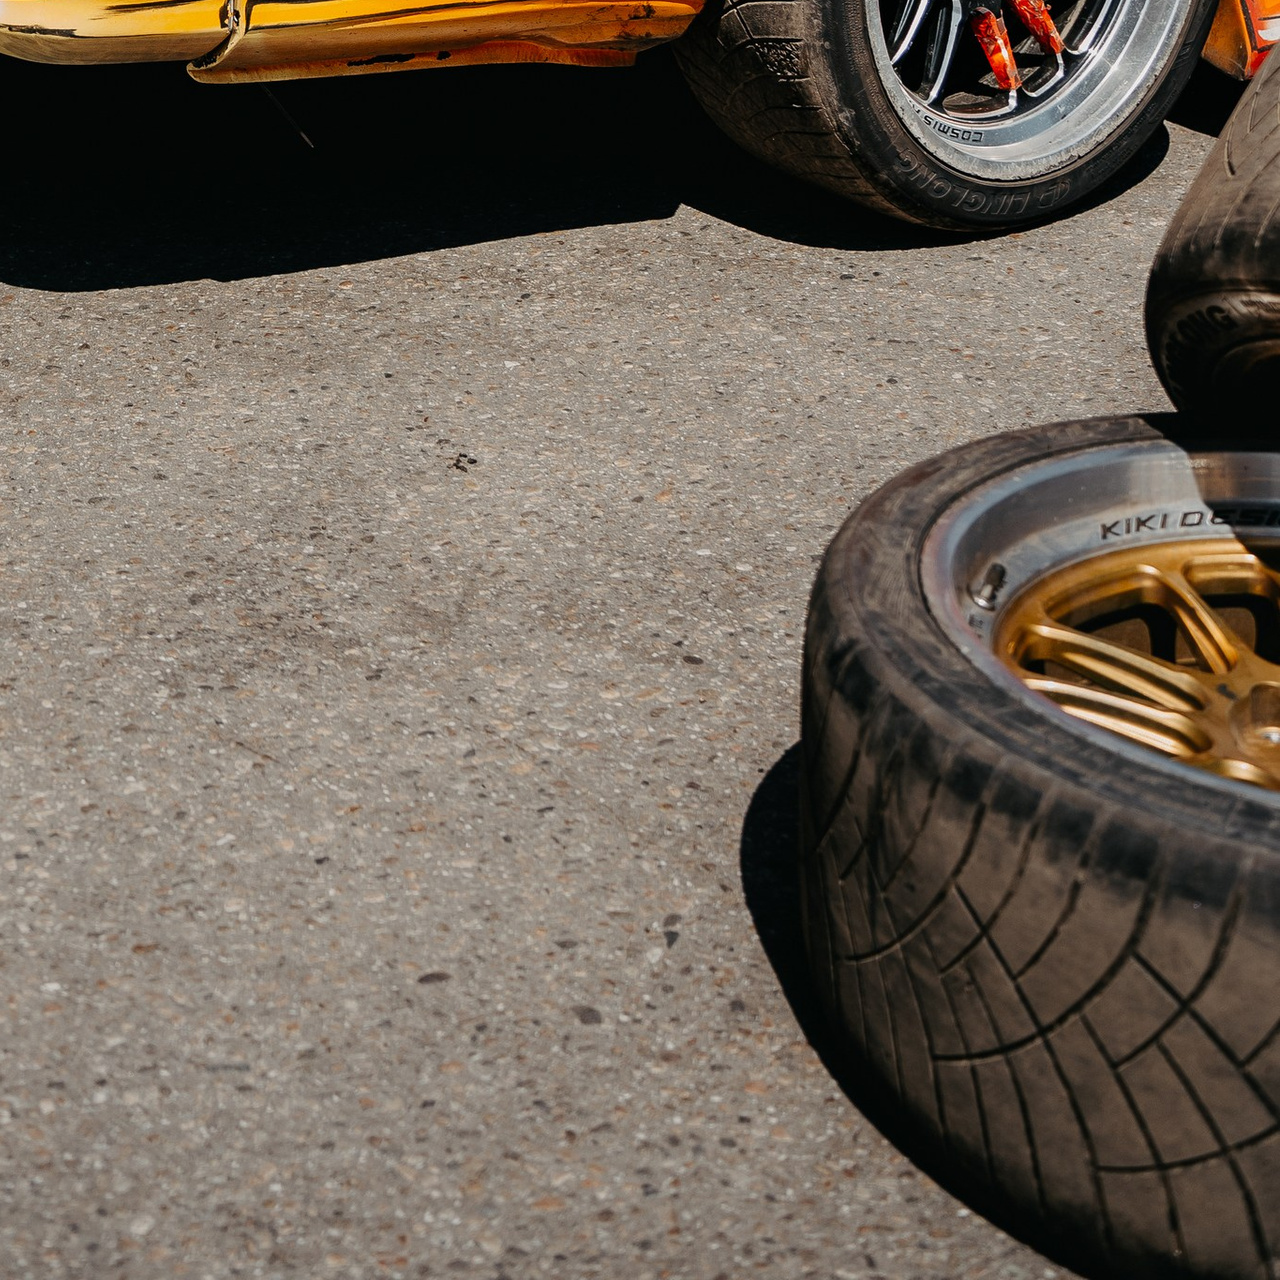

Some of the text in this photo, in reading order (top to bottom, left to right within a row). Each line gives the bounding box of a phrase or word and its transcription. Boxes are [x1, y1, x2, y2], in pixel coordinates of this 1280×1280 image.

[923, 115, 983, 143] COSMIS
[895, 148, 1031, 215] LINGLONG
[1099, 509, 1280, 541] KIKI DESI
